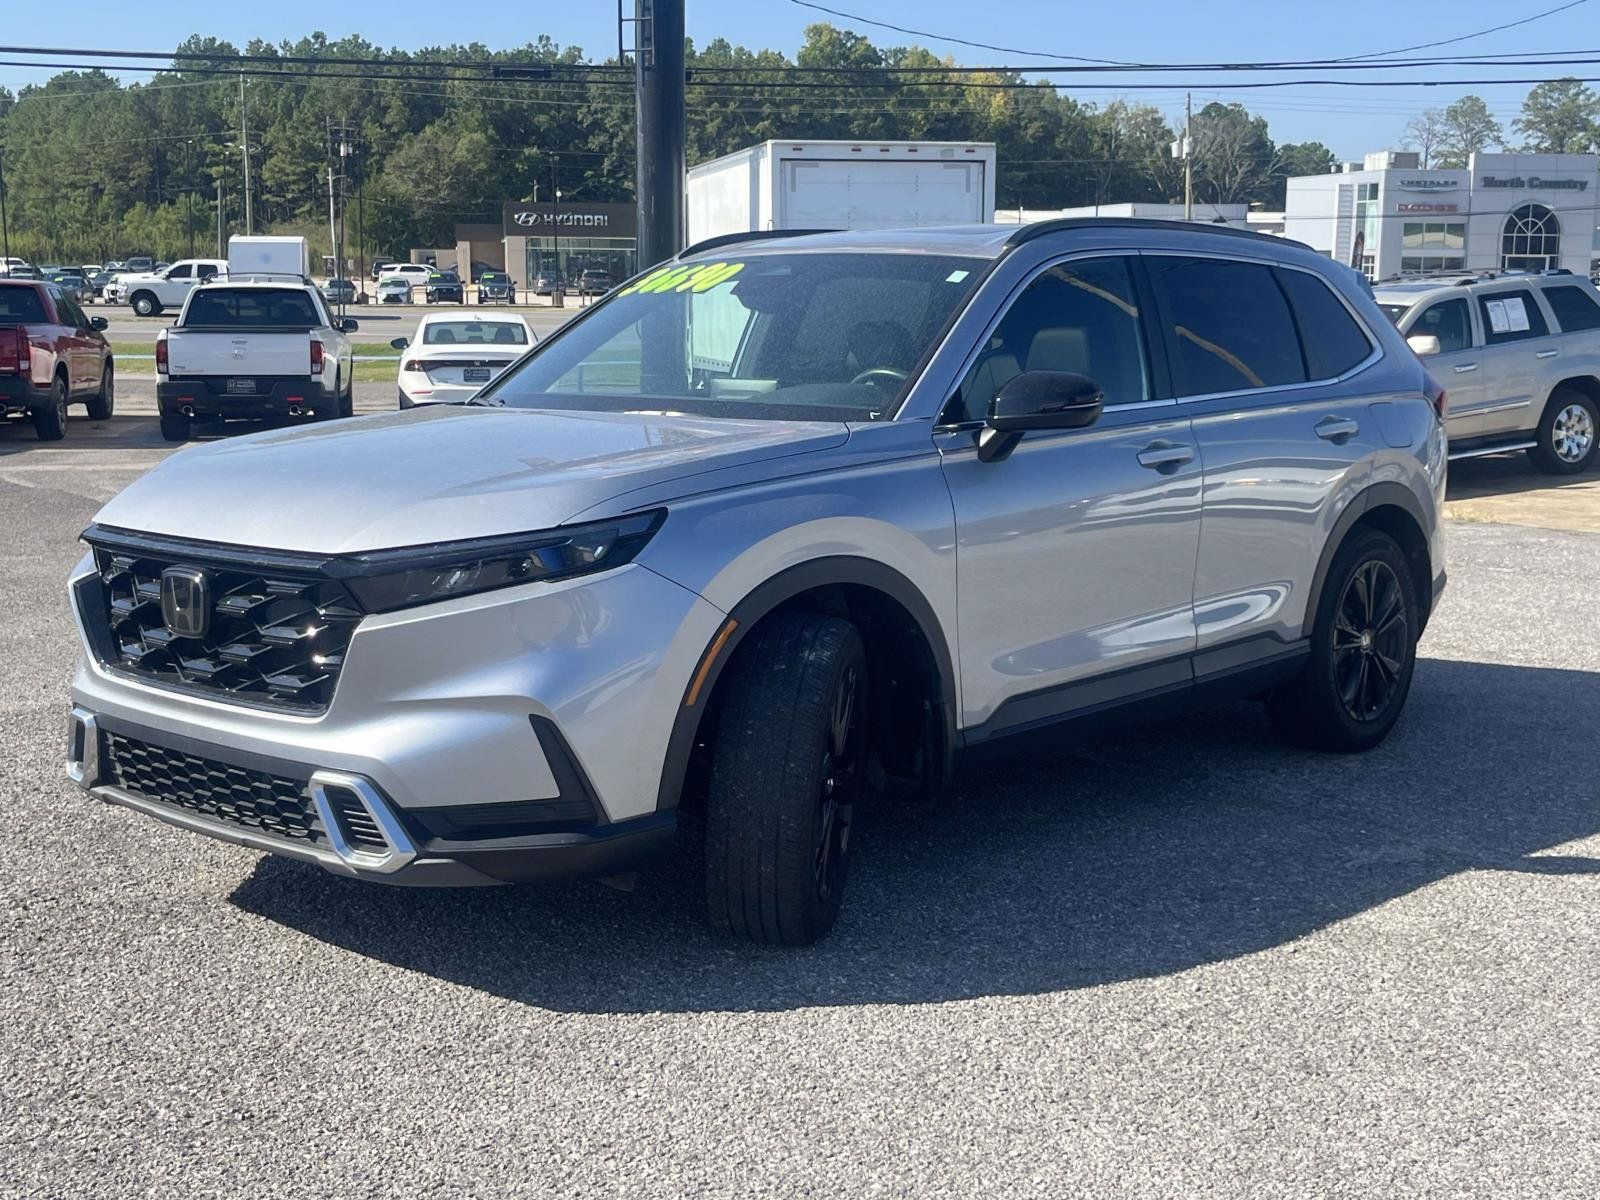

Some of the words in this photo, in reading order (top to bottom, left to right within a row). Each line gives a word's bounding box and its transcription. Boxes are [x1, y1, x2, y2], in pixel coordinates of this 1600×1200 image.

[1482, 176, 1525, 188] North
[1528, 176, 1588, 191] Country
[543, 213, 608, 226] HYUNDAI
